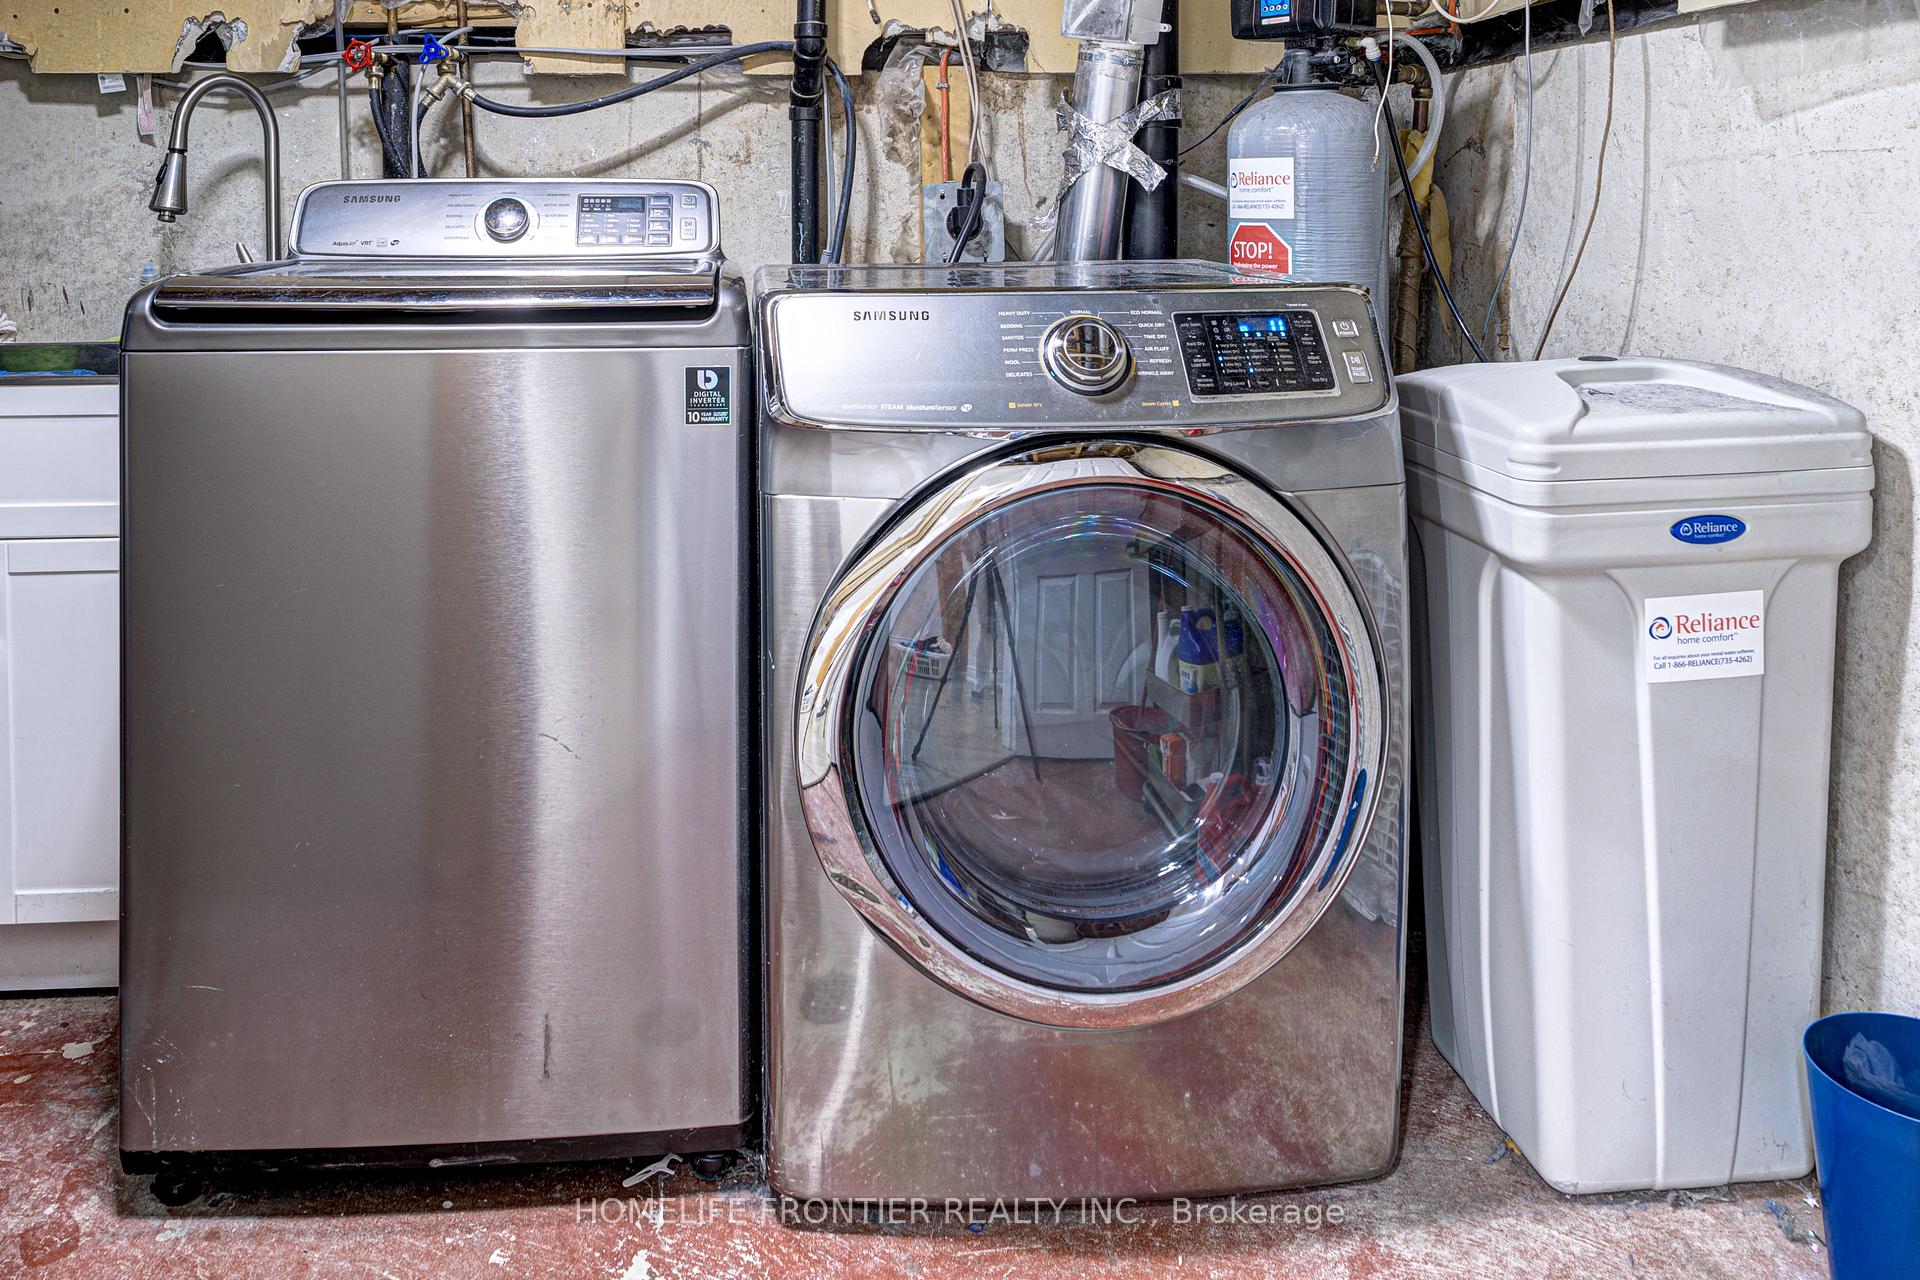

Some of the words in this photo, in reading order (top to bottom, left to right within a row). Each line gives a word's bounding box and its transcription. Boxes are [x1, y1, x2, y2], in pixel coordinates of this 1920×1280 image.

[1238, 172, 1291, 186] Reliance
[344, 195, 400, 203] SAMSUNG
[1234, 241, 1273, 260] STOP!
[853, 311, 930, 321] SAMSUNG
[688, 412, 700, 423] 10
[1693, 522, 1738, 534] Reliance
[1675, 613, 1760, 634] Reliance
[1677, 637, 1700, 645] home
[1654, 662, 1666, 670] Call
[1668, 655, 1752, 668] 1-866-RELIANCE(735-4262)
